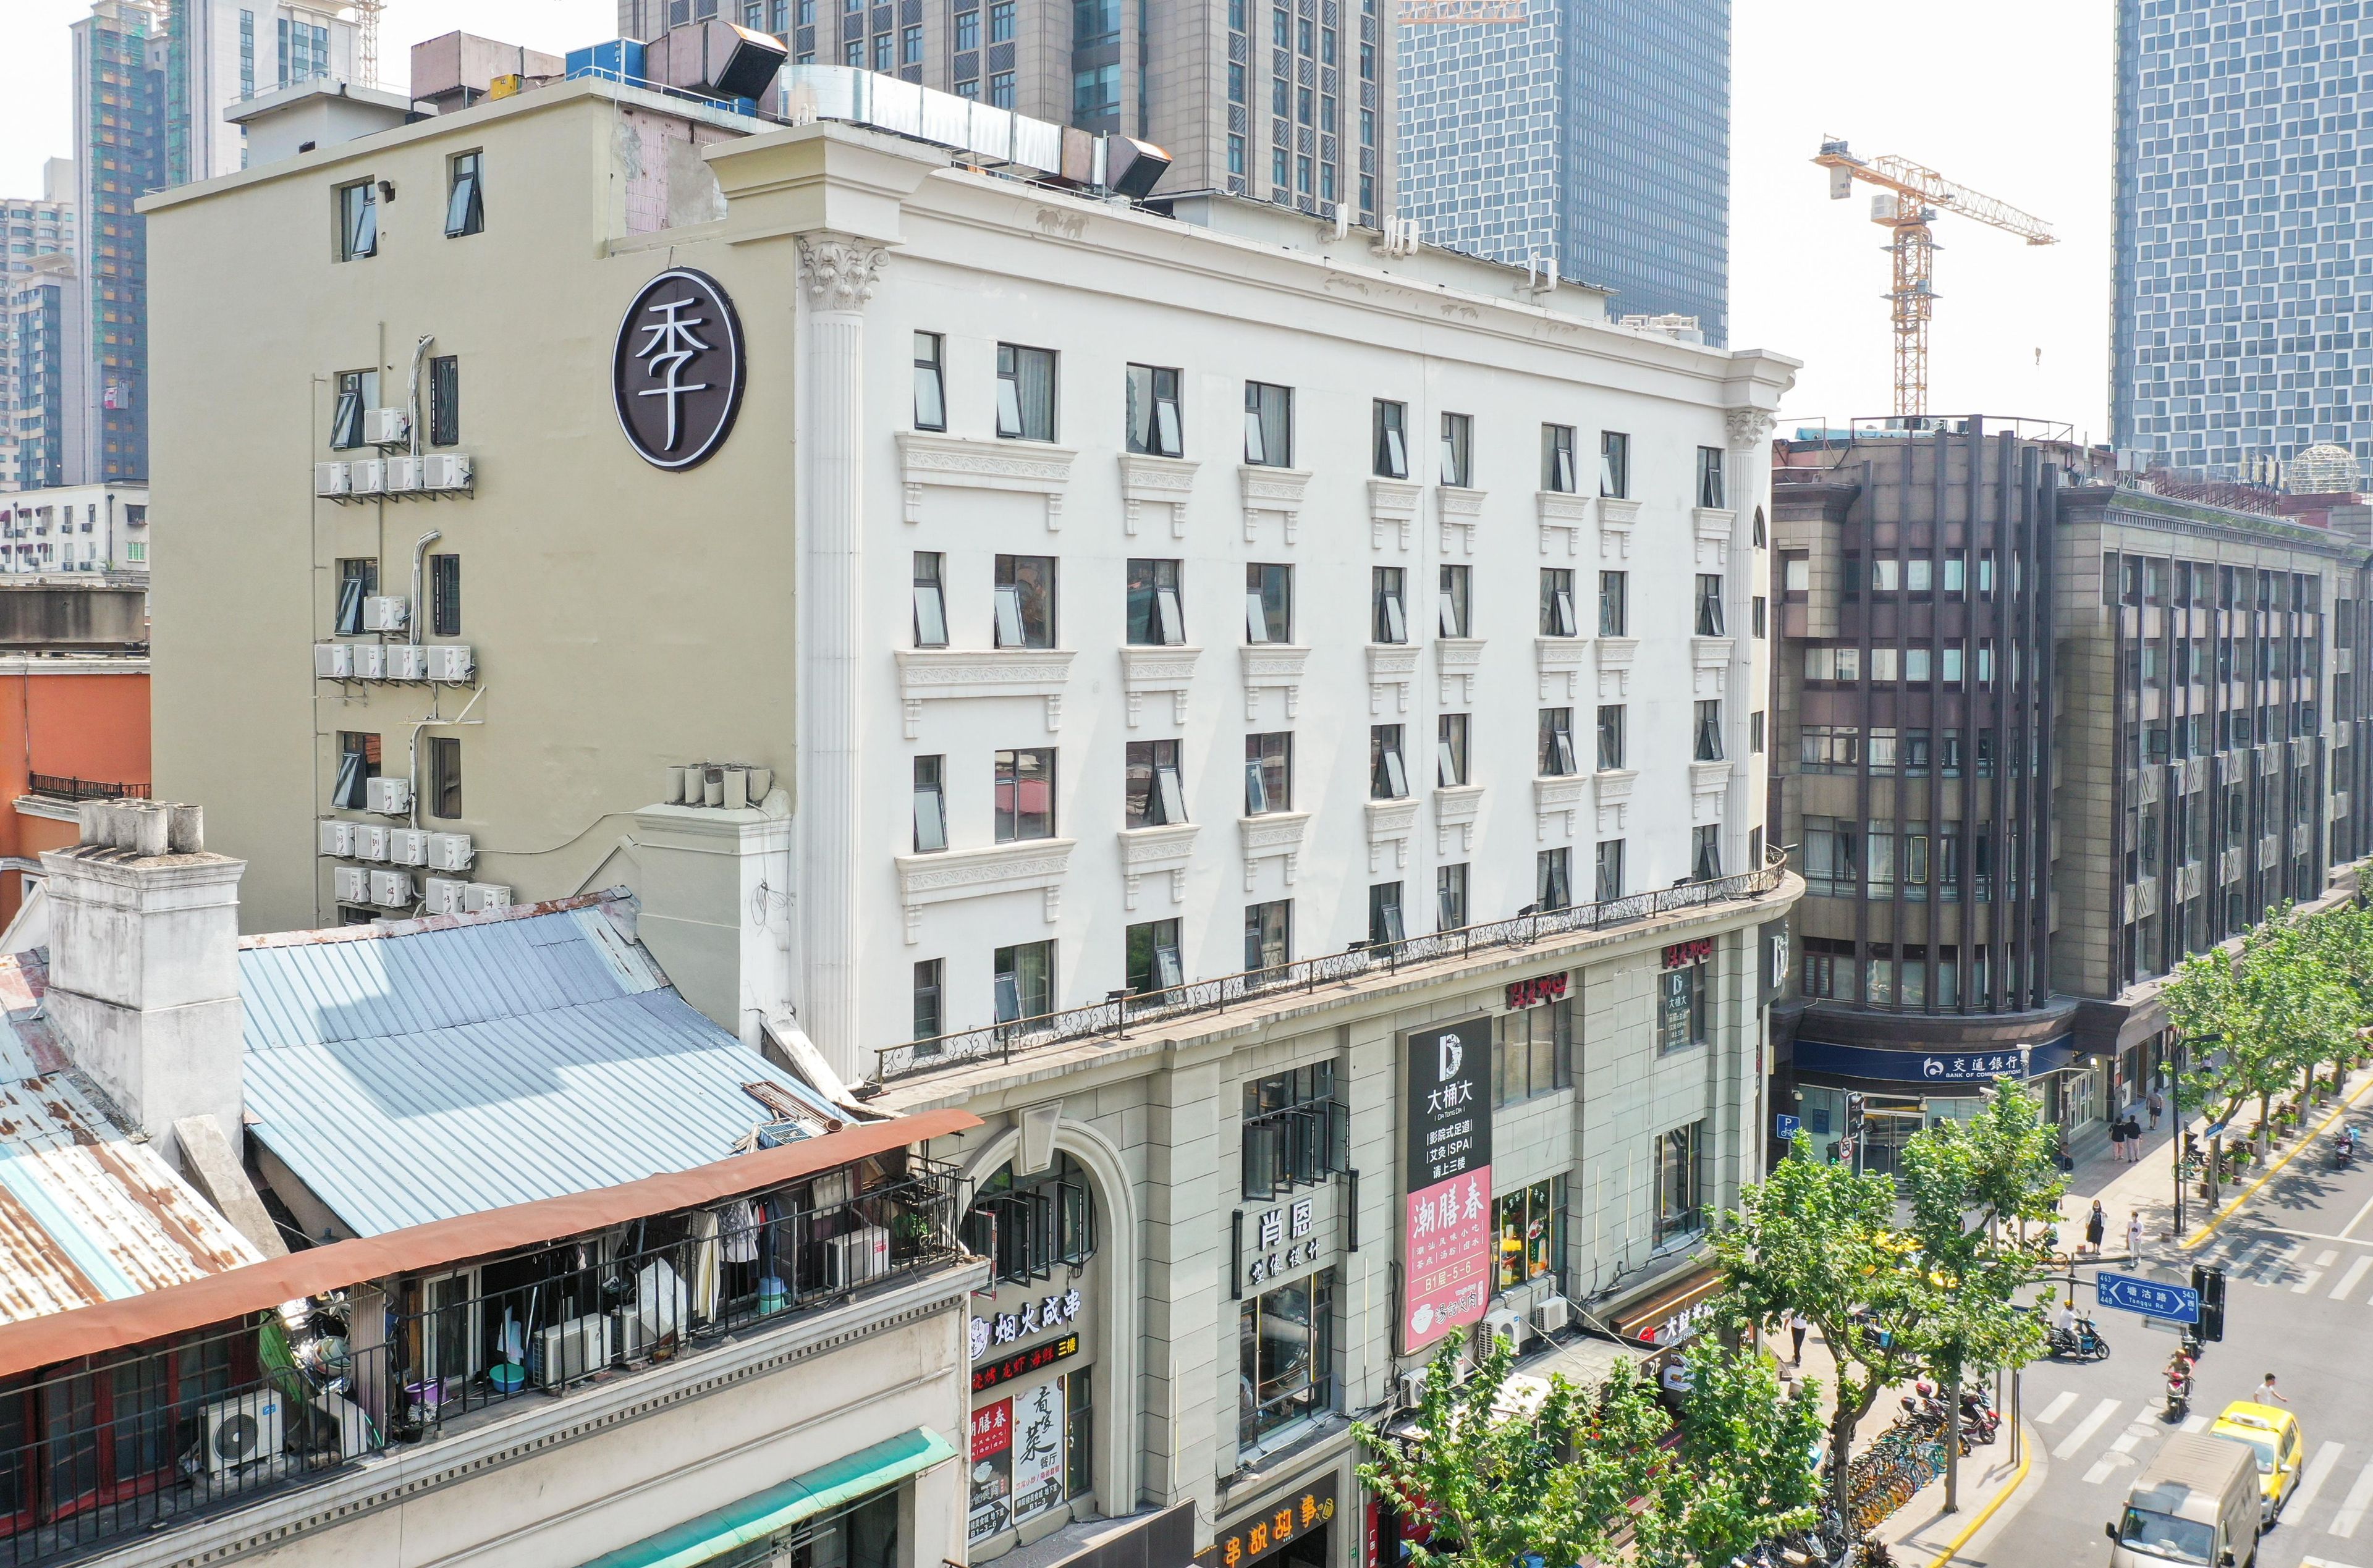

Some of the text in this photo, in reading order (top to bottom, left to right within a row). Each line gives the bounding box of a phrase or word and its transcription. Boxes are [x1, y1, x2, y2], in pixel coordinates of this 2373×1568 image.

[635, 297, 709, 451] 季
[1952, 1055, 2018, 1073] 交通銀行
[1427, 1079, 1473, 1115] 大桶大
[1785, 1117, 1792, 1126] P
[1429, 1121, 1470, 1144] 影院式足道
[1450, 1139, 1470, 1155] SPA
[1433, 1156, 1466, 1179] 请上三楼
[1413, 1175, 1484, 1239] 潮膳春
[1260, 1197, 1313, 1251] 肖恩
[2100, 1275, 2111, 1283] 463
[2100, 1296, 2113, 1305] 448
[2126, 1286, 2167, 1303] 塘沽路
[2182, 1290, 2194, 1299] 543
[2128, 1297, 2165, 1310] Tanggu Rd.
[1058, 1338, 1076, 1356] 三楼
[1040, 1452, 1057, 1469] 餐厅
[1029, 1497, 1046, 1511] B1-3
[971, 1520, 997, 1537] B1-3-6
